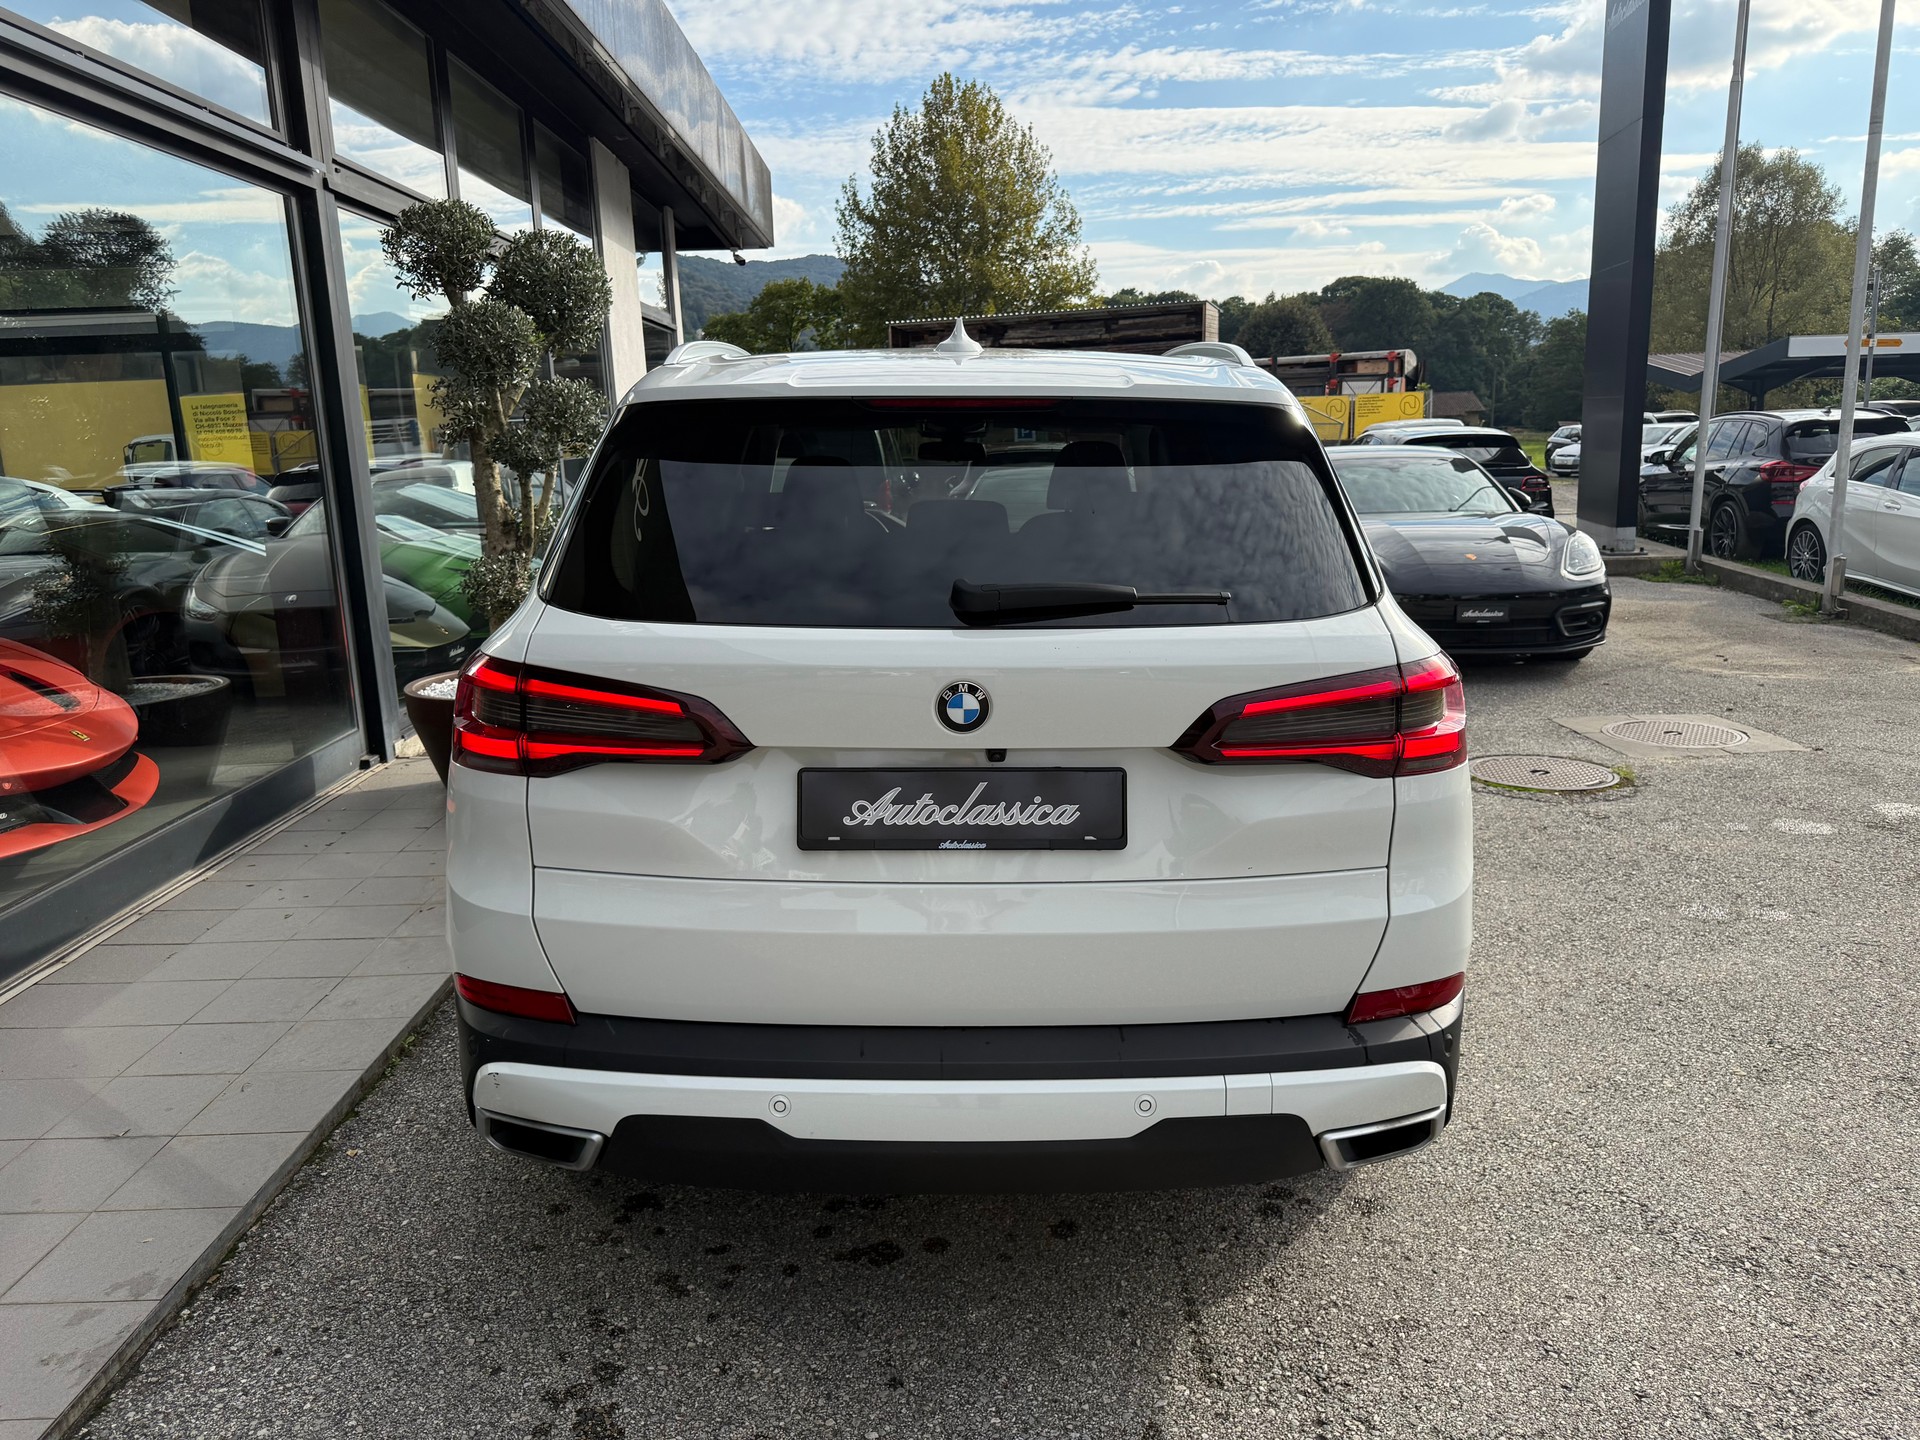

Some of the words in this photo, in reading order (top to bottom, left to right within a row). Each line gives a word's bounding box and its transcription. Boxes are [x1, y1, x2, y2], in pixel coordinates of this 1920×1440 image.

[1461, 608, 1504, 618] Autoclassica
[842, 781, 1081, 826] Autoclassica
[938, 839, 987, 849] Autoclassica
